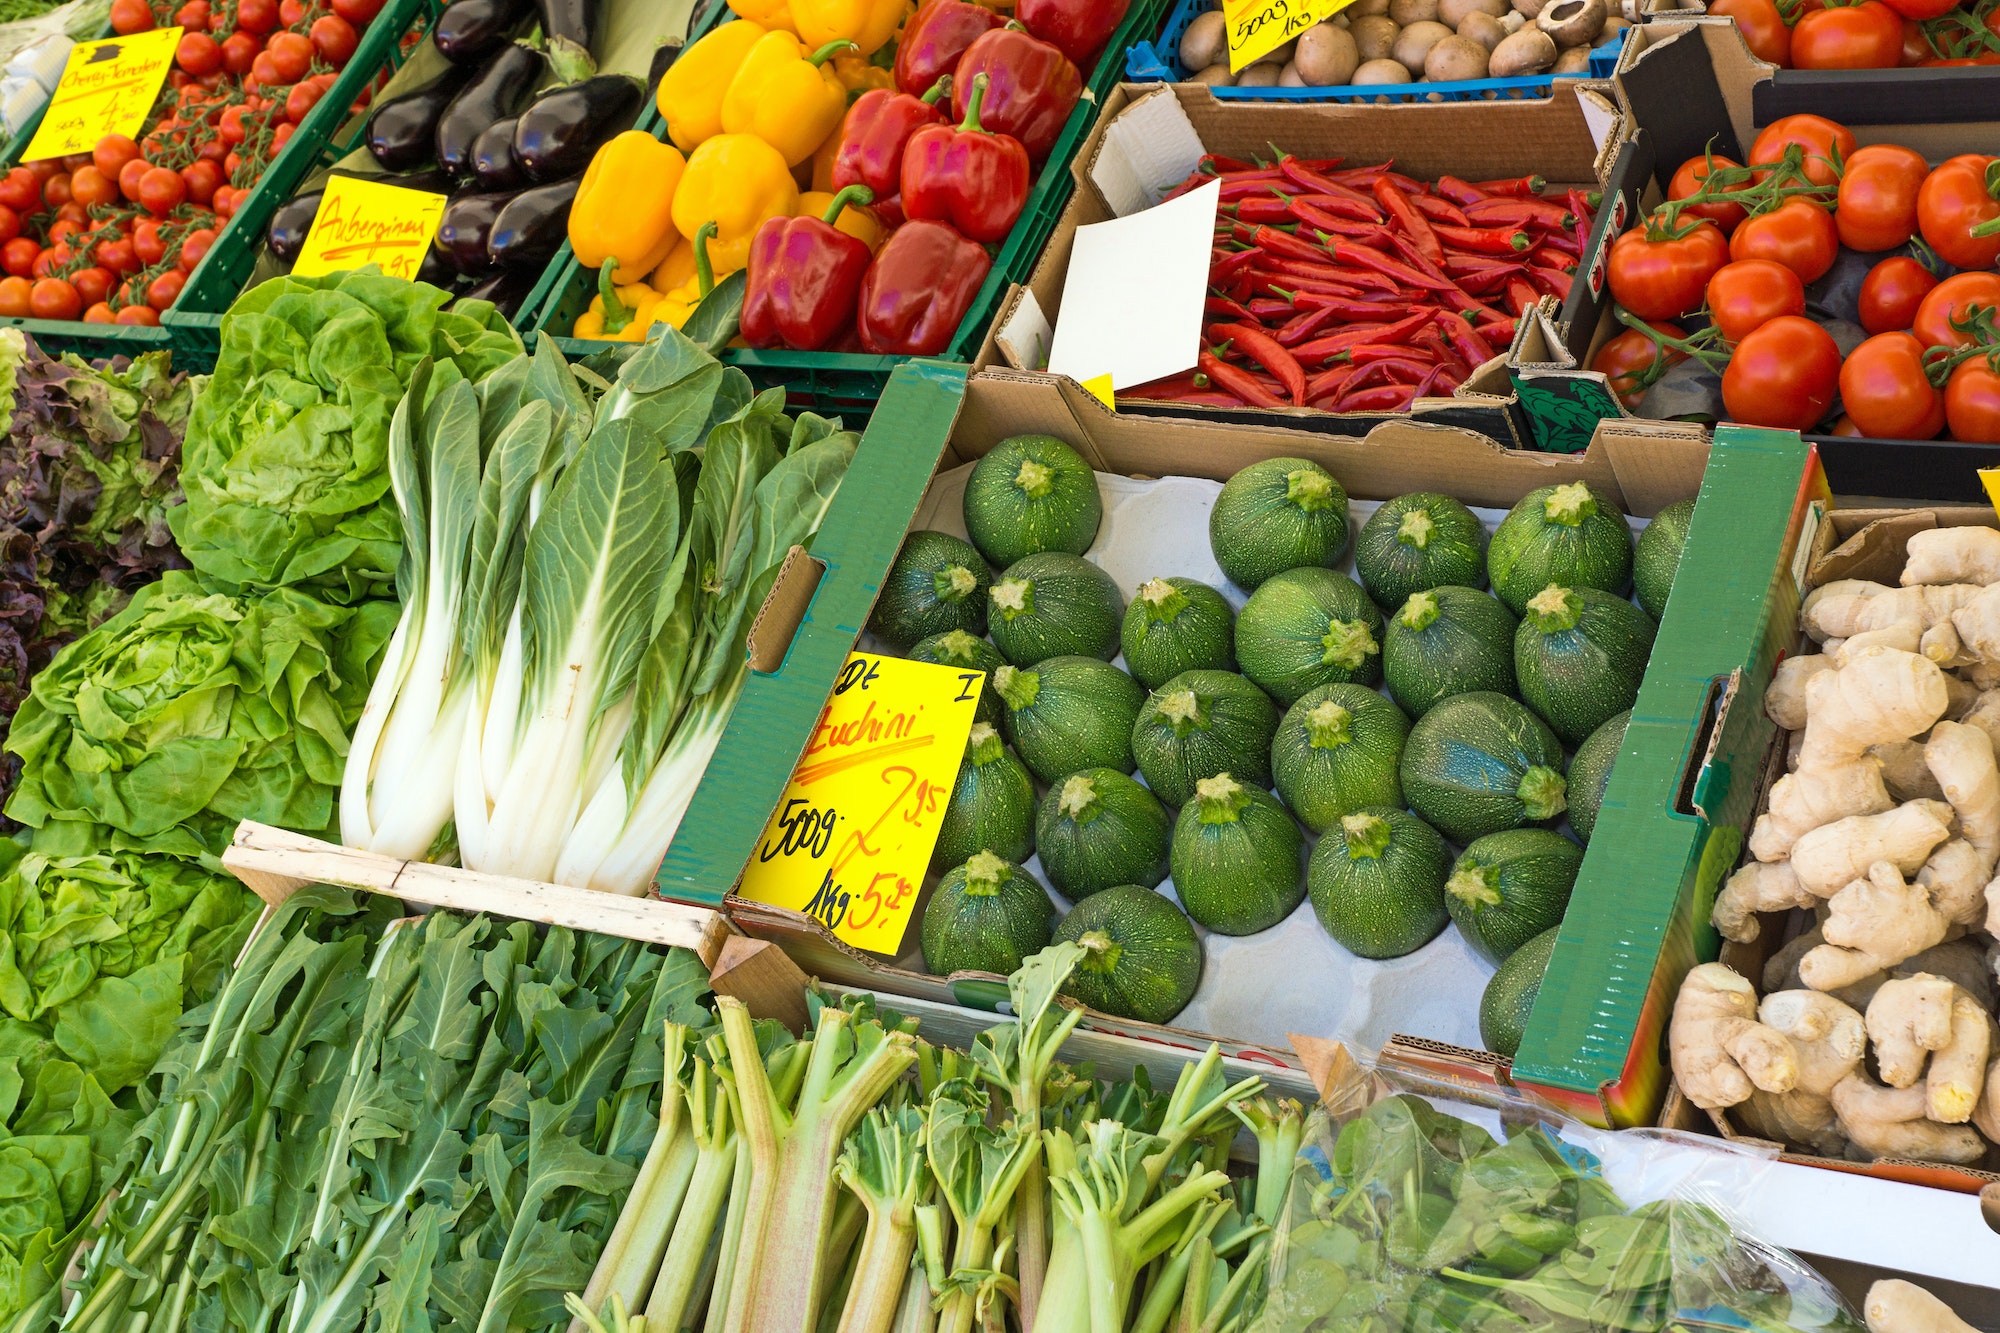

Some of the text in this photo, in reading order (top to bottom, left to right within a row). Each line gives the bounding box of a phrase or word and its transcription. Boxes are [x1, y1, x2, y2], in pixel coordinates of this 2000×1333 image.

[1231, 0, 1289, 51] 500g
[314, 195, 425, 261] Auberginen
[953, 673, 983, 703] I
